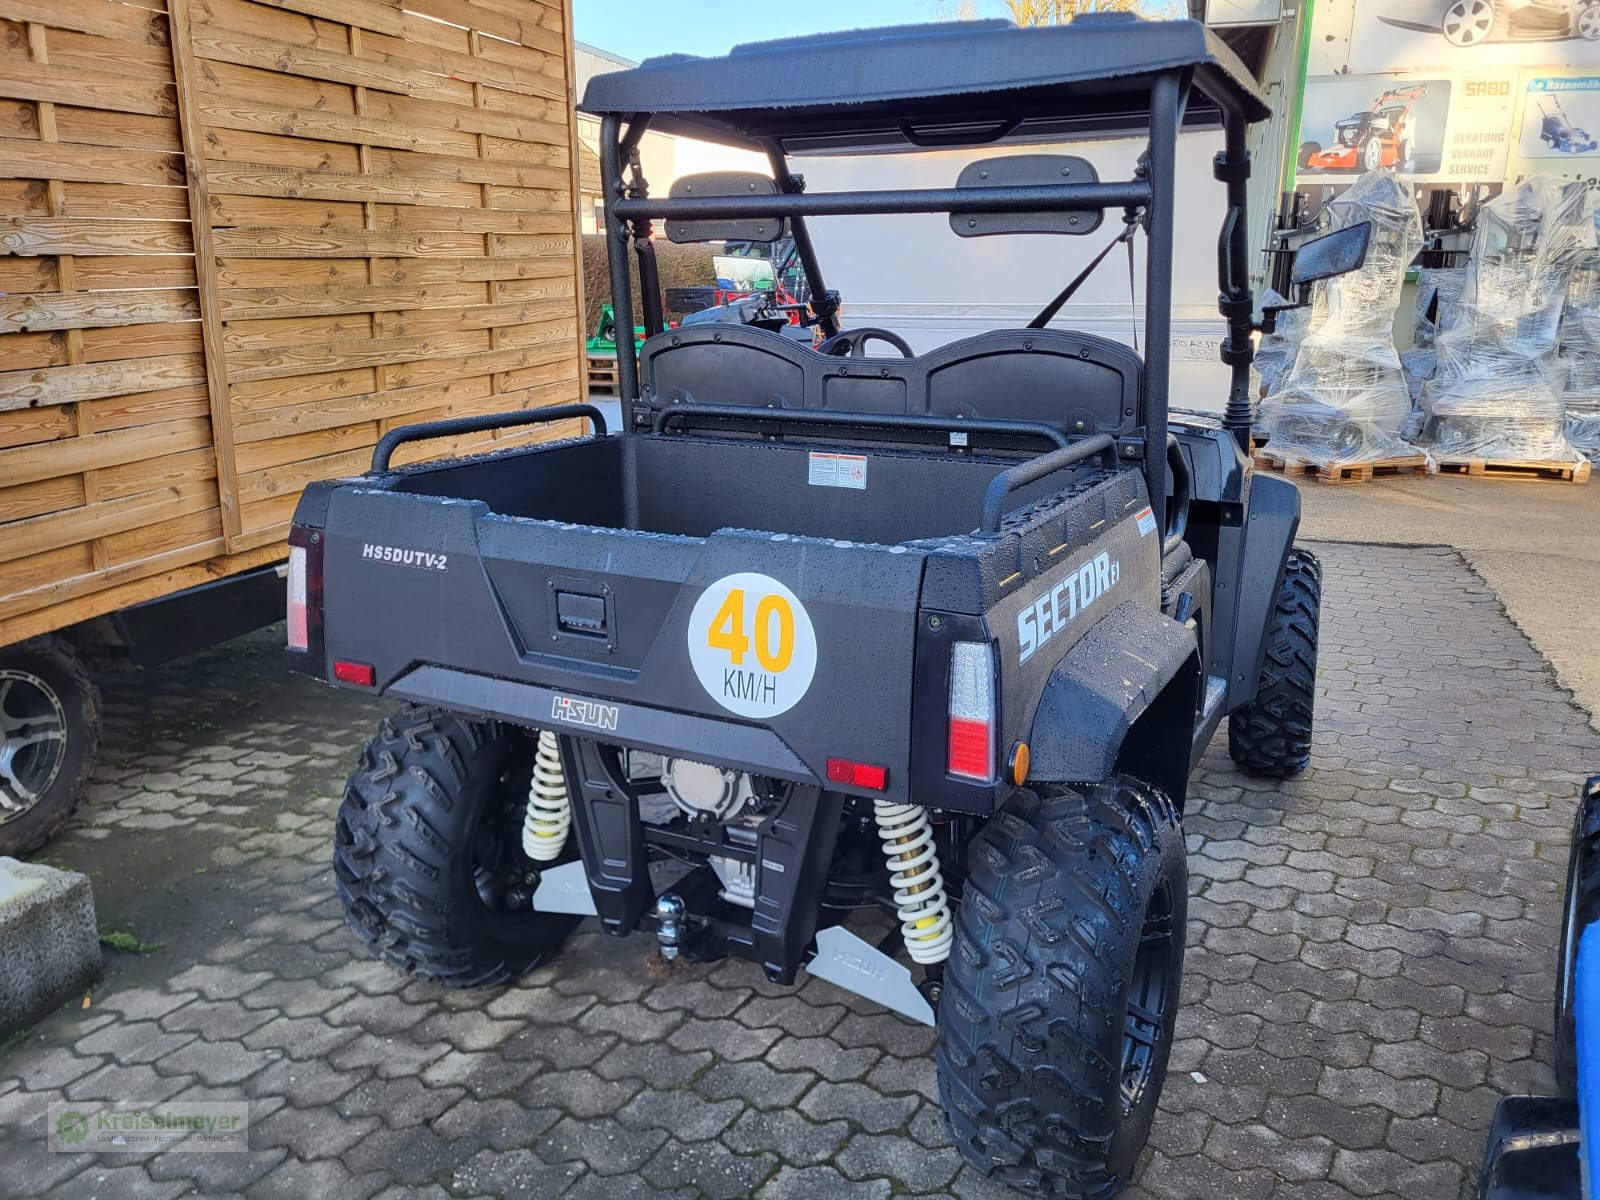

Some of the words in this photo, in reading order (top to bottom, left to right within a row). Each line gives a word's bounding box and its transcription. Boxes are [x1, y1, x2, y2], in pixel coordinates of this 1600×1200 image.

[1464, 81, 1510, 96] SABO
[1453, 131, 1505, 144] BERATUNG
[1451, 148, 1495, 160] VERKAUF
[1448, 163, 1490, 175] SERVICE
[362, 543, 447, 570] HS5DUTV-2
[1017, 550, 1111, 665] SECTOR
[707, 588, 796, 674] 40
[723, 668, 777, 705] KM/H
